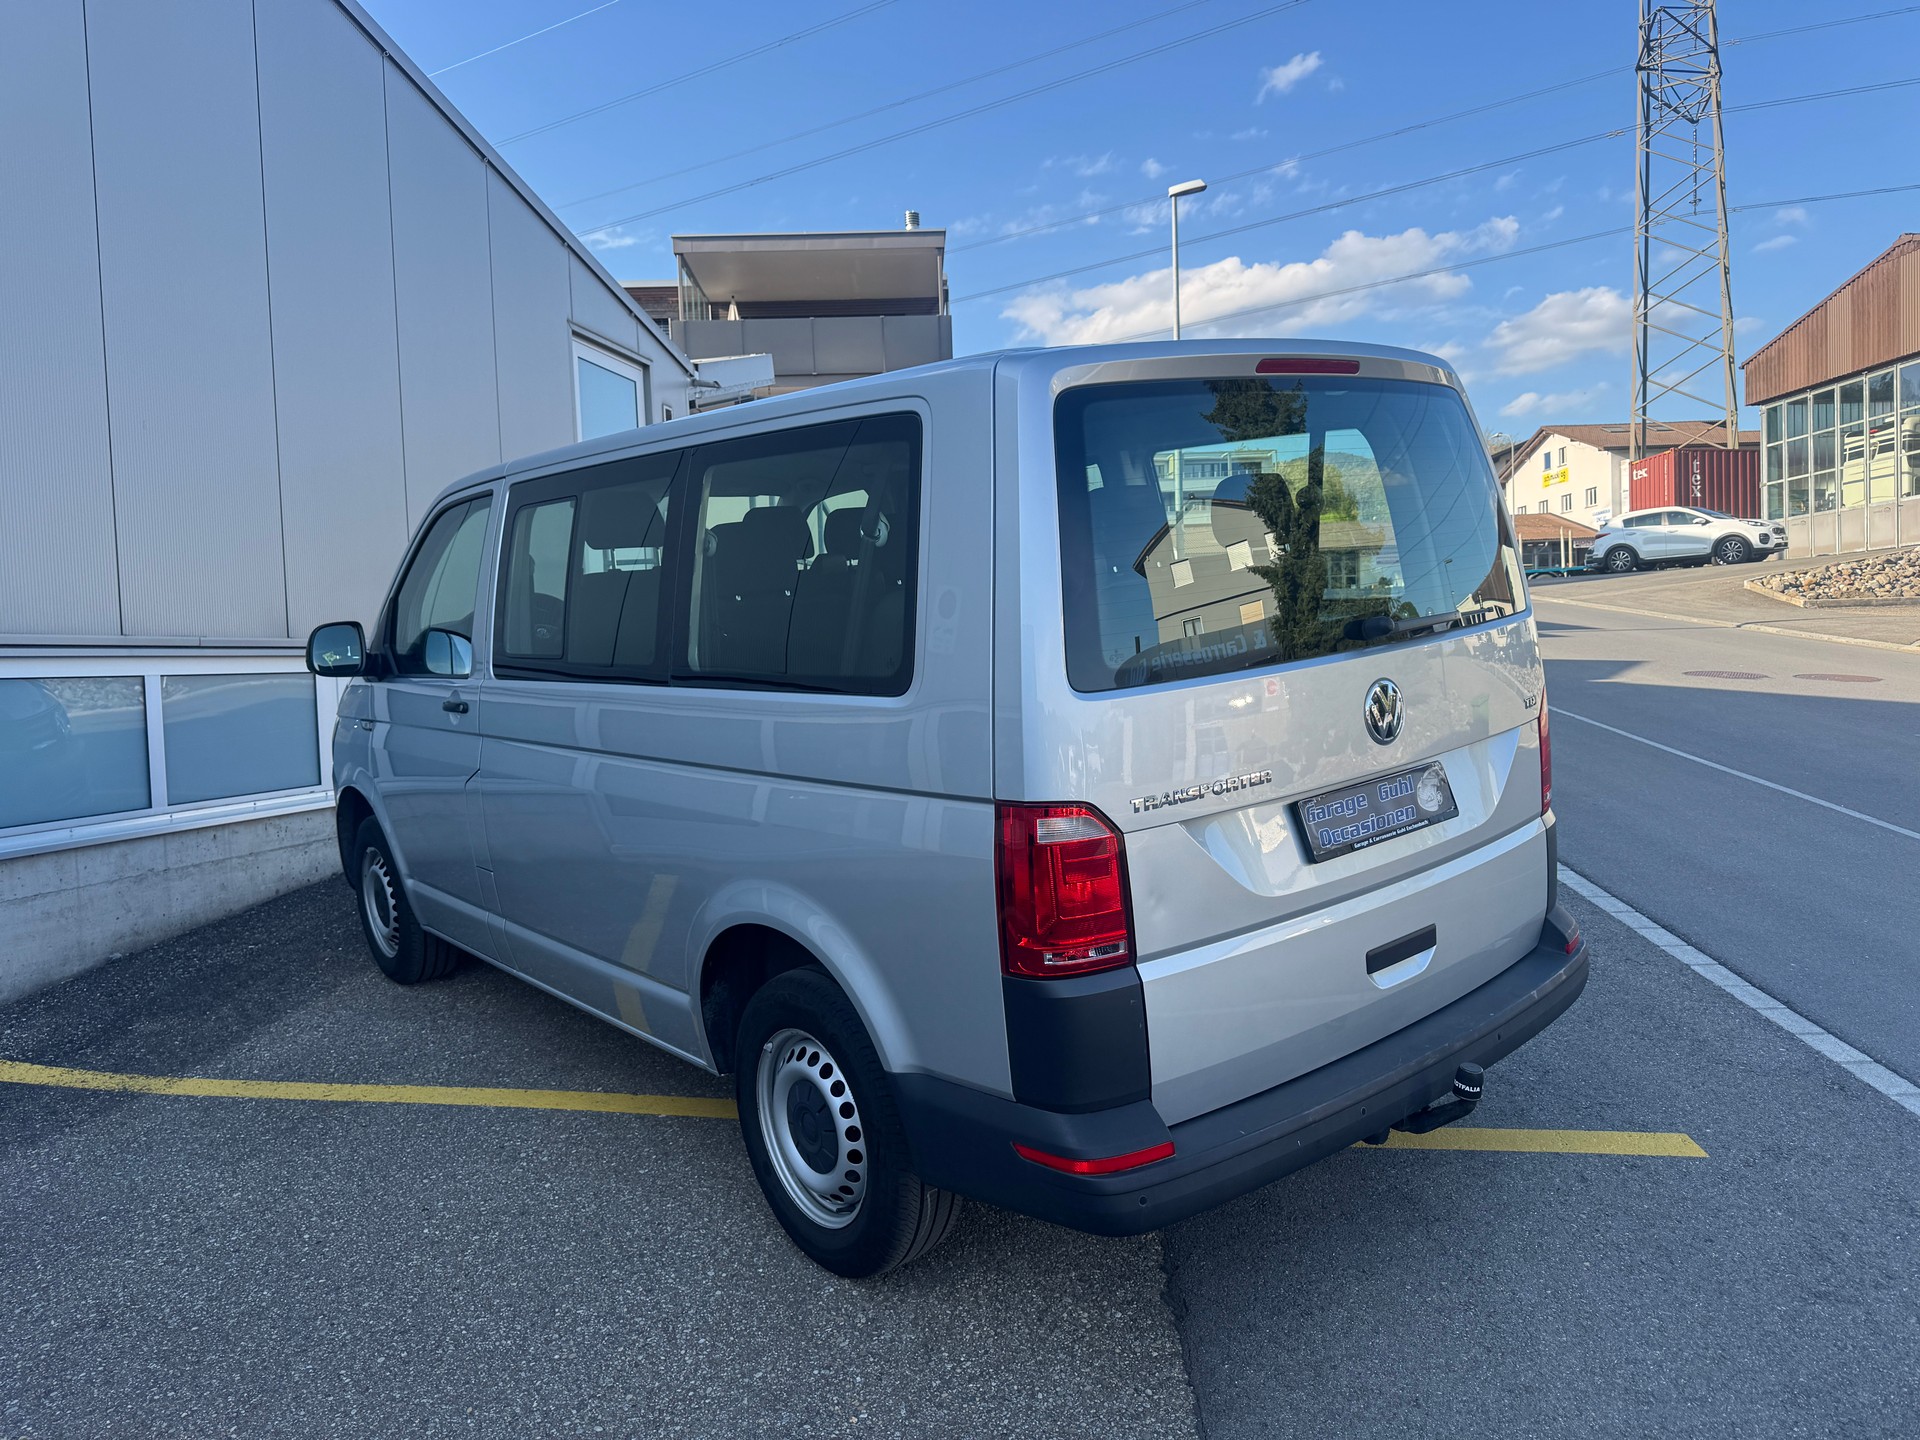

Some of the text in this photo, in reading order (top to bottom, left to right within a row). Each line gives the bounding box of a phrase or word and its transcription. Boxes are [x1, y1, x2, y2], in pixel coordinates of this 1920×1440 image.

[1691, 458, 1702, 497] tex
[1129, 769, 1273, 814] TRANSPORTER
[1305, 774, 1415, 825] Garage Guhl
[1318, 804, 1417, 849] Occasionen
[1353, 840, 1369, 849] Garage
